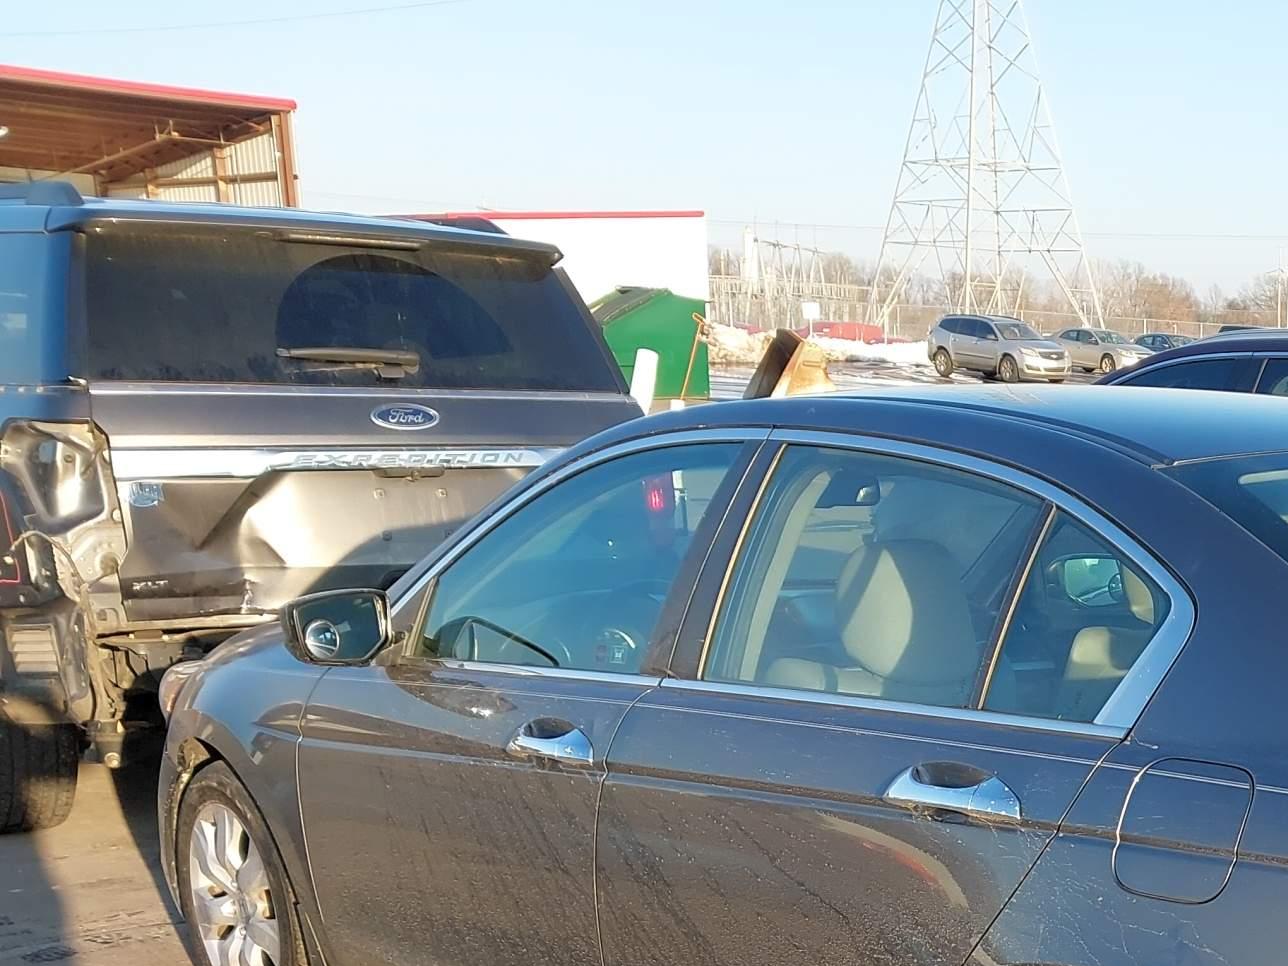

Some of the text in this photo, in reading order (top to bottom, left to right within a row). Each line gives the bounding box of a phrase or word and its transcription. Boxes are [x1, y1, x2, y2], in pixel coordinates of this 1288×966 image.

[388, 408, 425, 424] Ford
[293, 452, 523, 467] EXPEDITION
[132, 580, 169, 592] XLT
